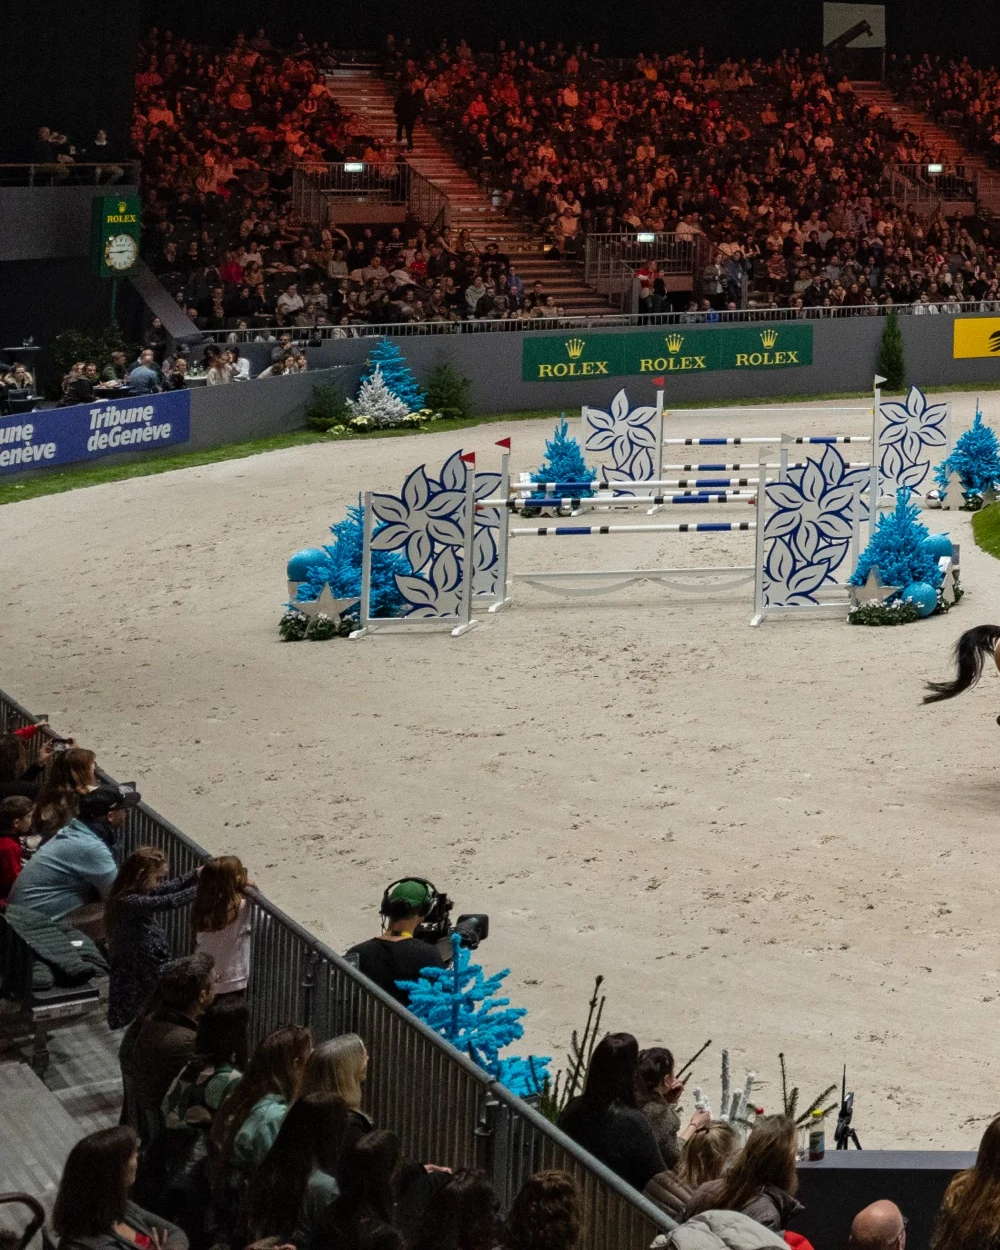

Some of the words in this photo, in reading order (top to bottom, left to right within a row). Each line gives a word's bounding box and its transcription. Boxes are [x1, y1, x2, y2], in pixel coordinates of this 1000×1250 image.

[107, 214, 137, 224] ROLEX
[639, 355, 707, 372] ROLEX
[735, 351, 799, 367] ROLEX
[538, 361, 609, 378] ROLEX
[89, 405, 154, 430] Tribune
[87, 421, 172, 452] deGenève
